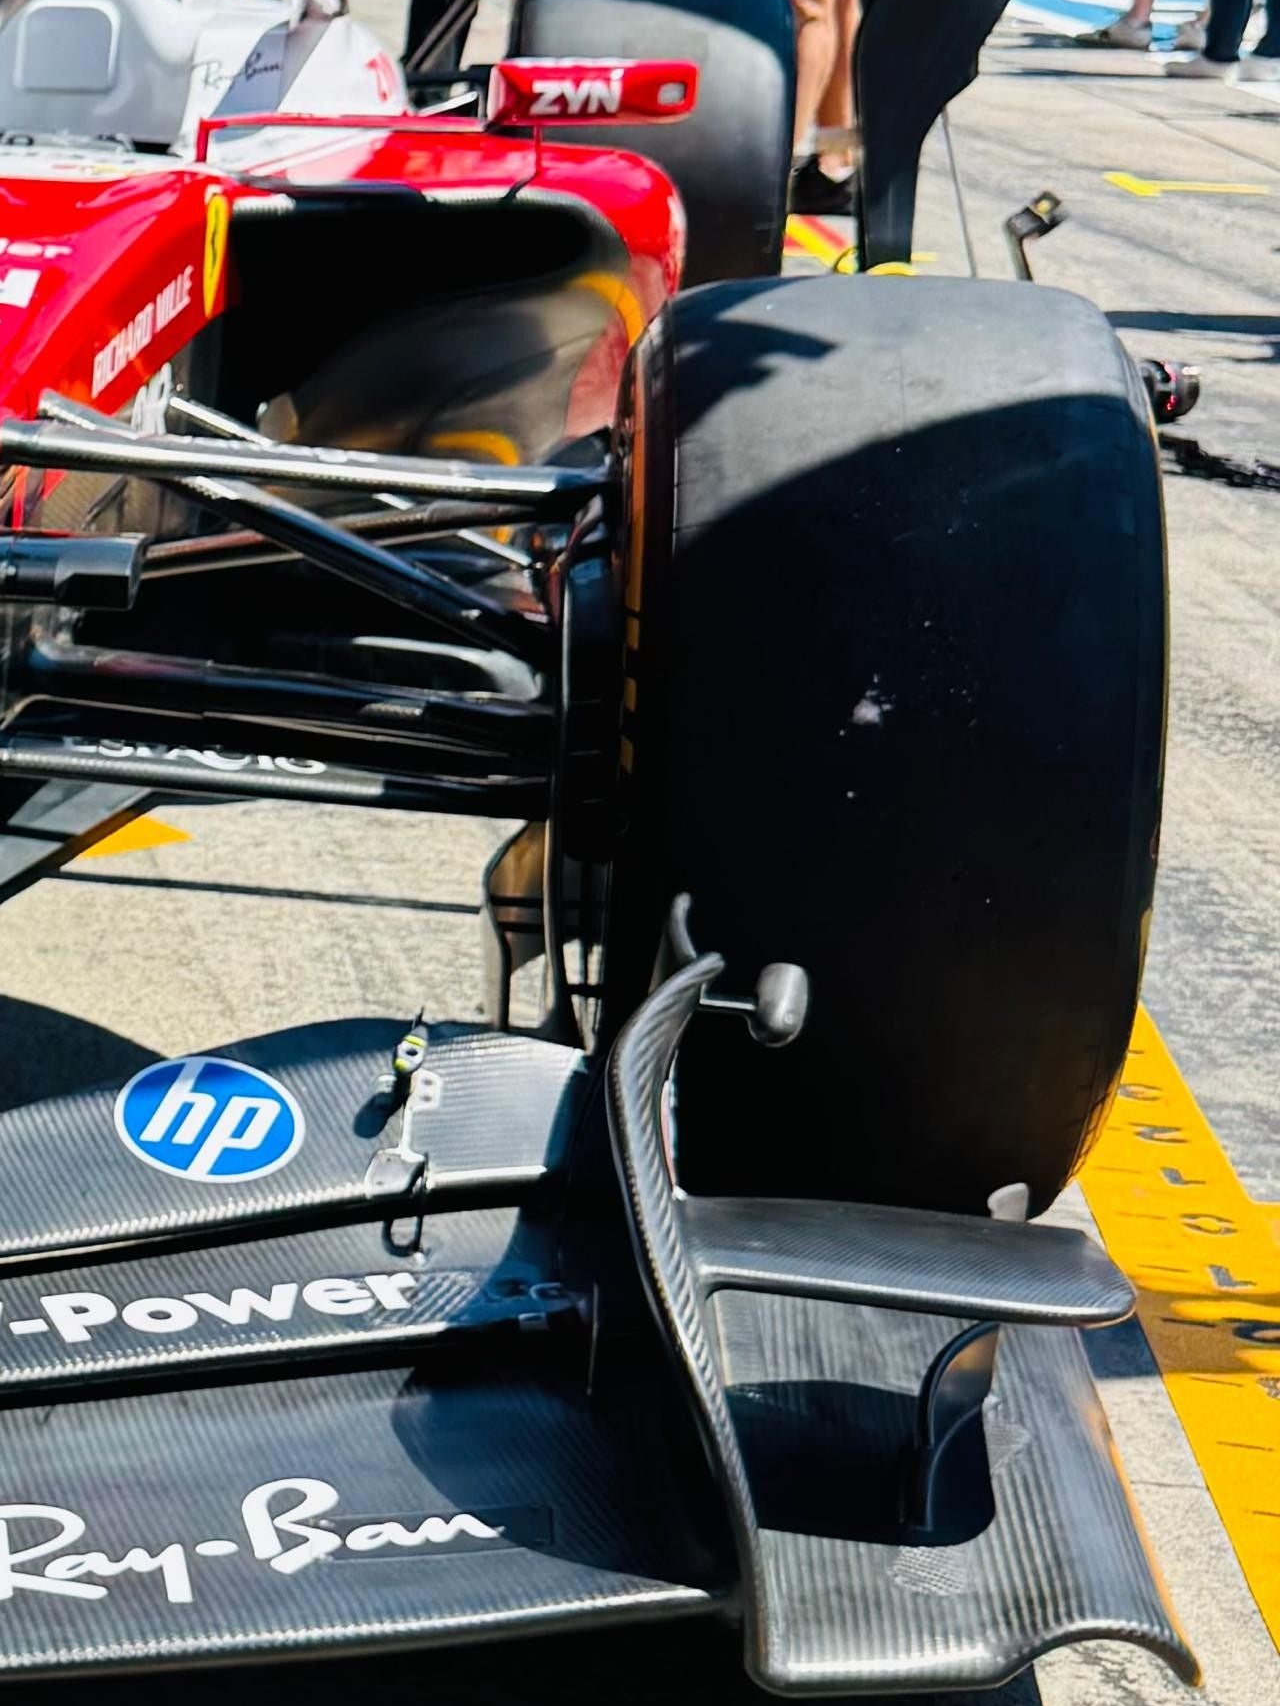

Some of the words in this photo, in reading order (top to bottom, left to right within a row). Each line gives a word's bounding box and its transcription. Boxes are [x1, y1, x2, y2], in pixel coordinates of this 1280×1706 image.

[529, 68, 625, 115] ZYN
[91, 301, 155, 399] RICHARD
[154, 264, 194, 334] MILLE
[132, 1057, 286, 1181] hp
